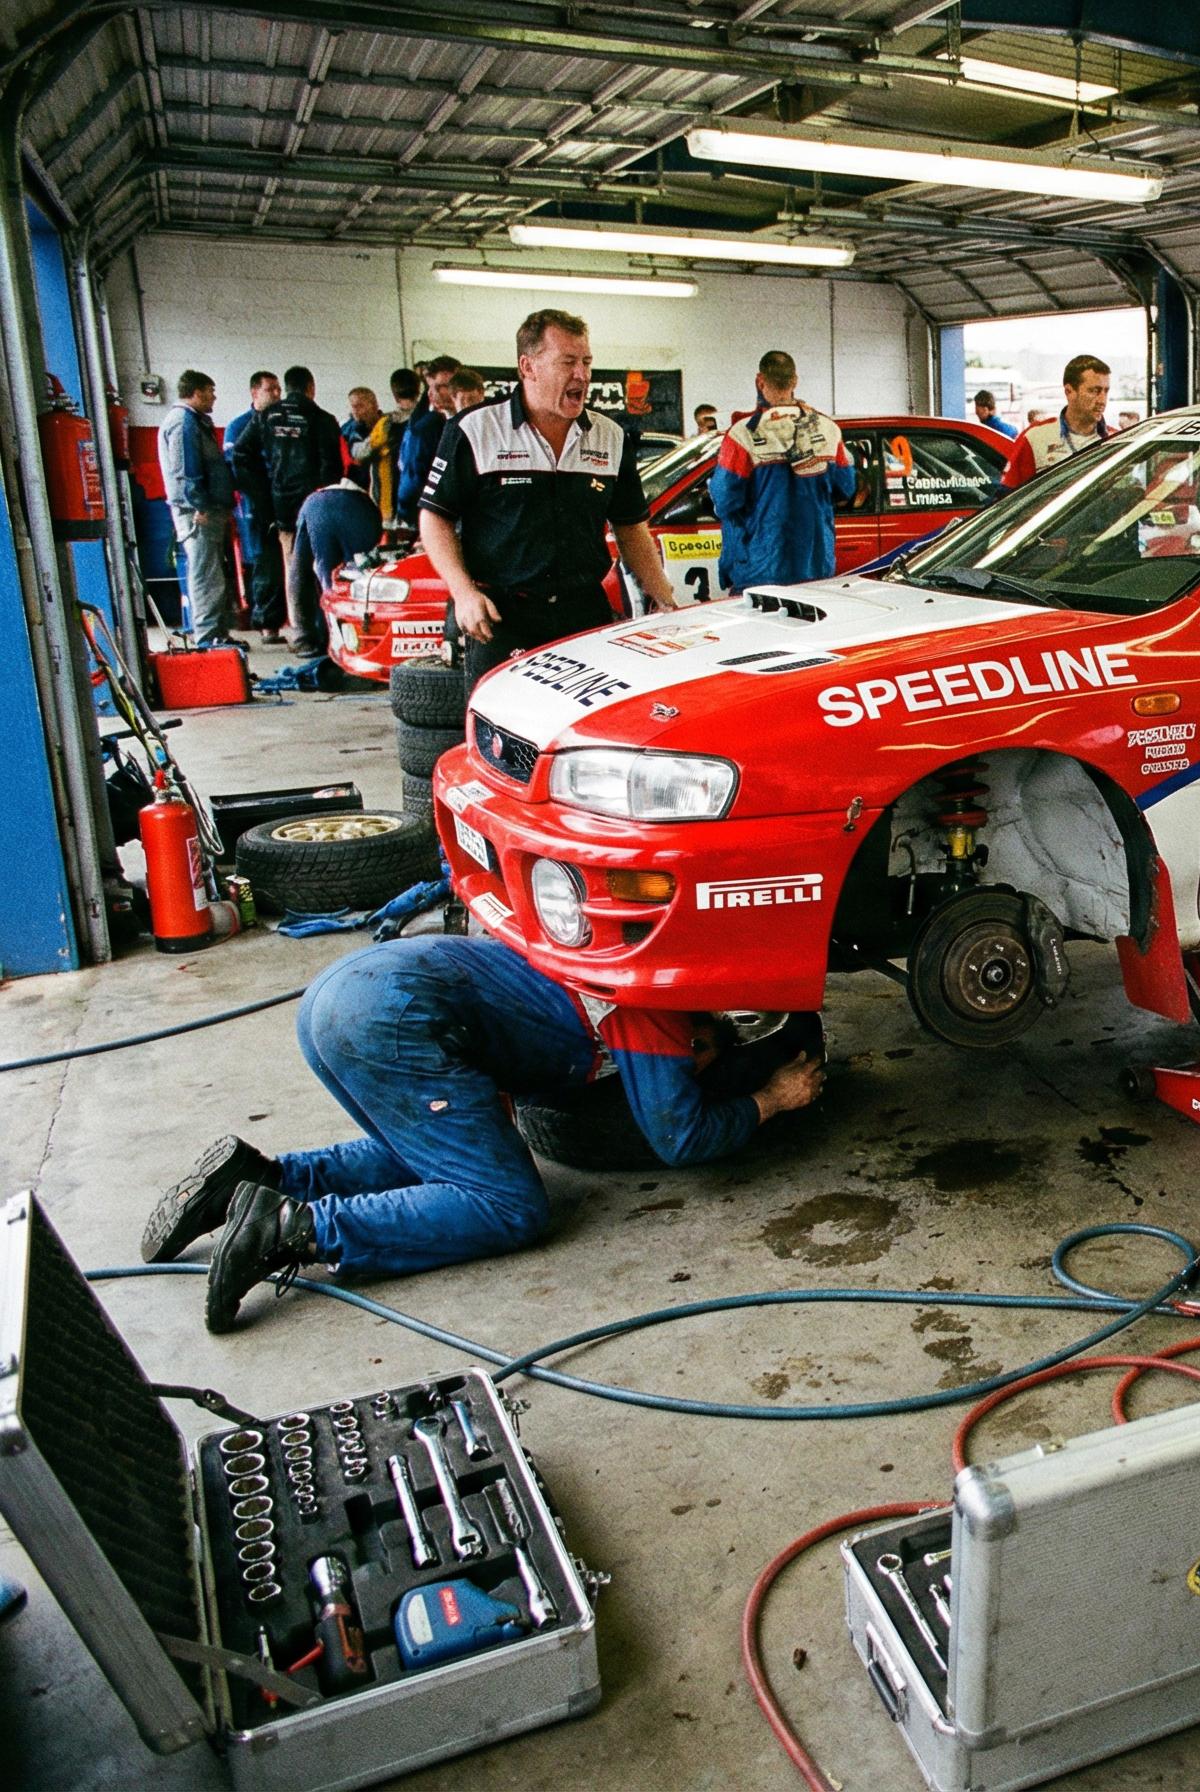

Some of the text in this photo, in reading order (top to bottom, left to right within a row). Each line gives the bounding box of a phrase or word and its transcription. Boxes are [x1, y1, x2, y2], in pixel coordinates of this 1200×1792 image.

[509, 652, 632, 707] SPEEDLINE
[817, 643, 1138, 727] SPEEDLINE
[696, 873, 823, 910] PIRELLI
